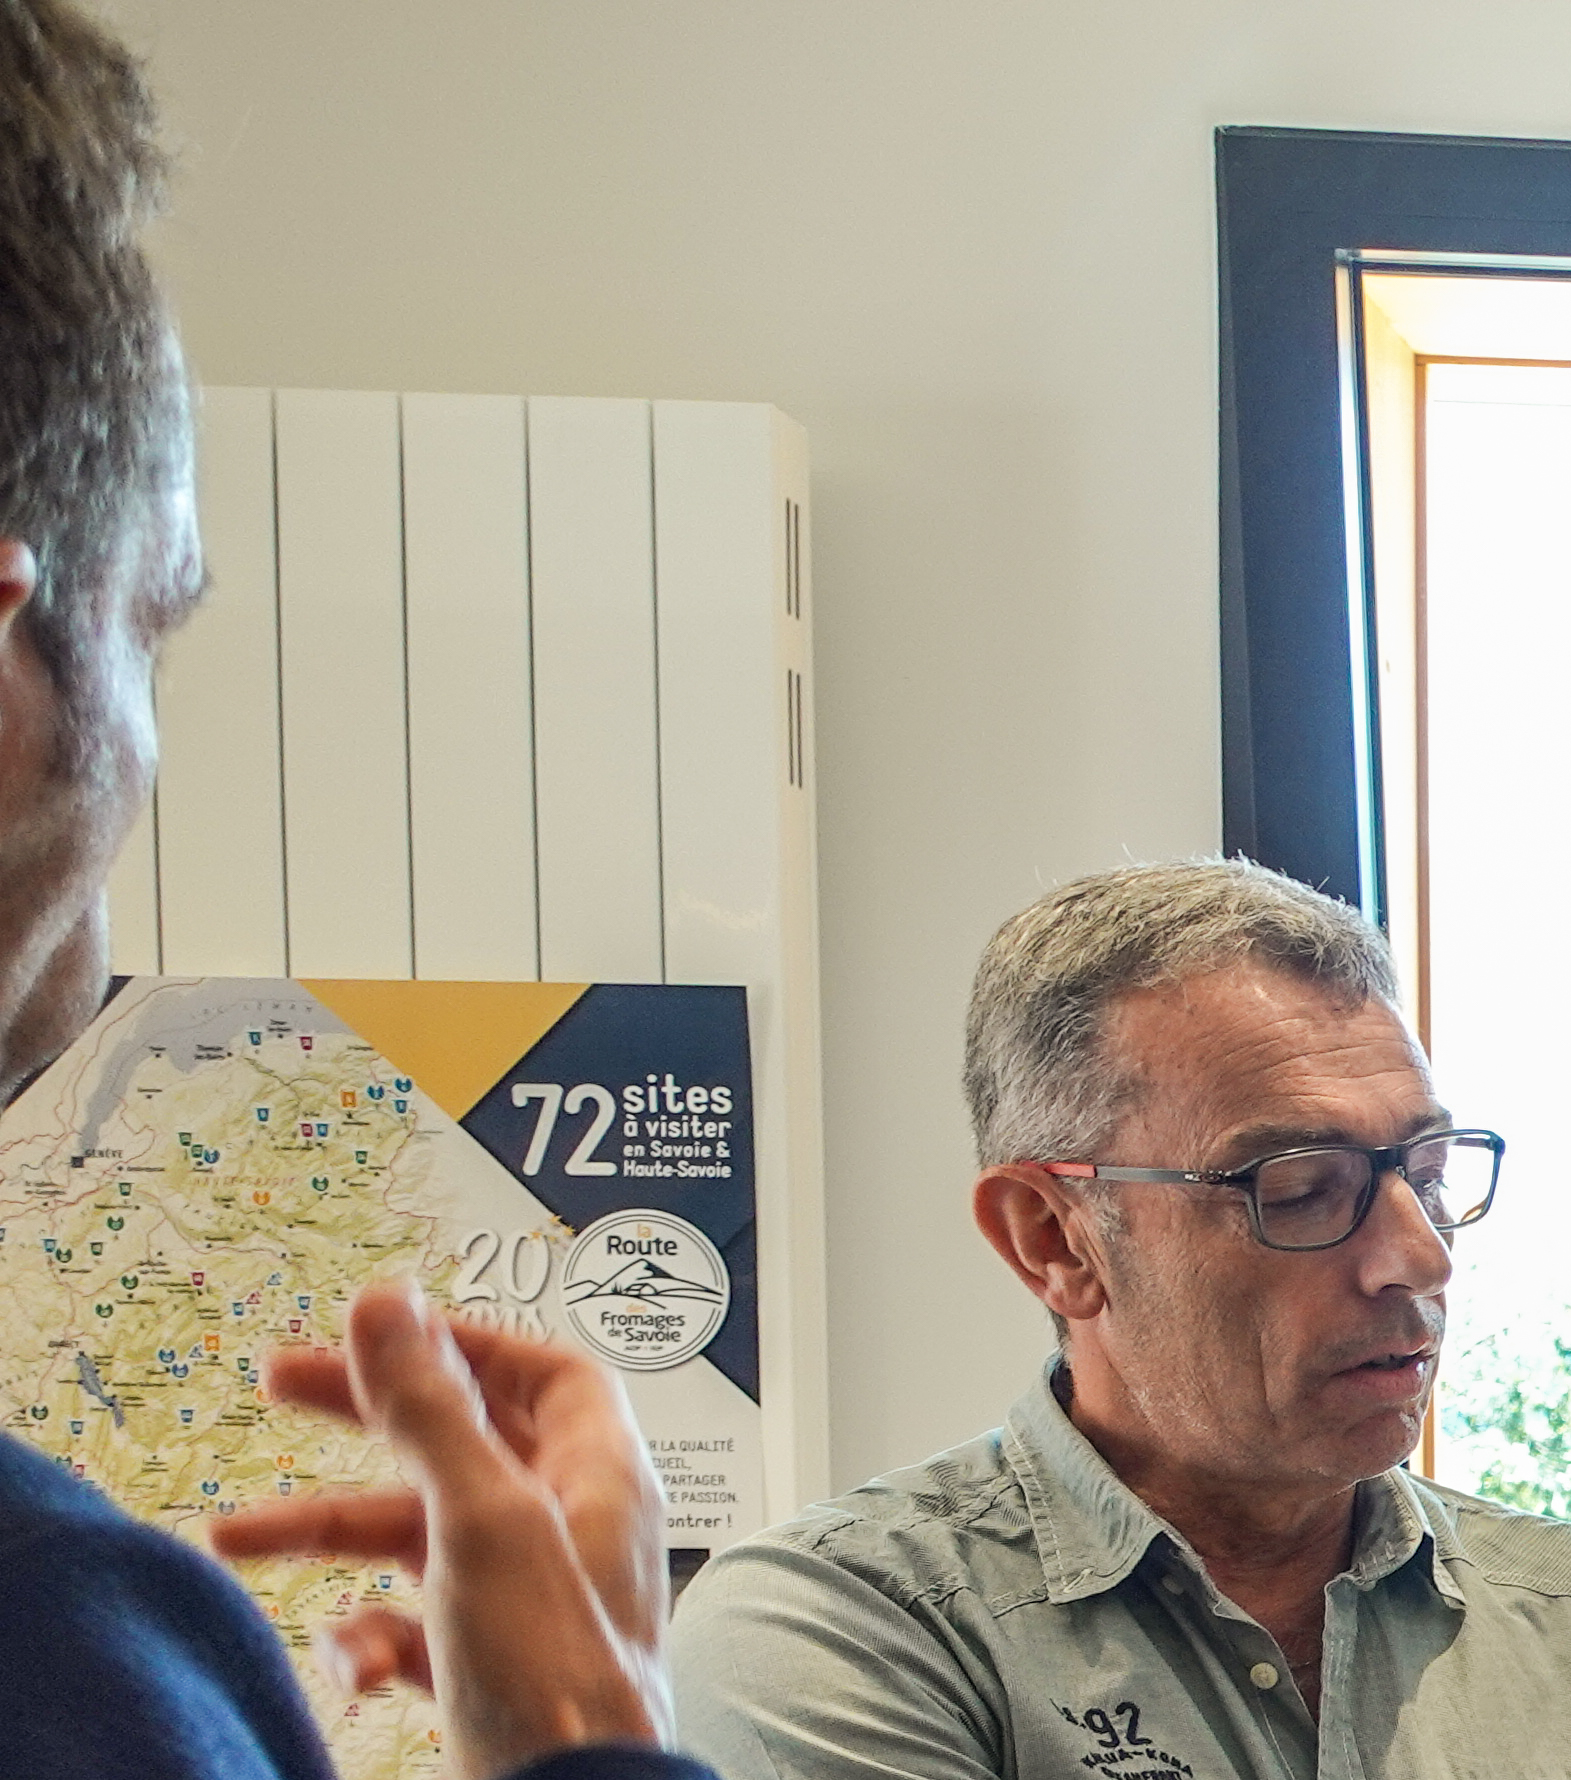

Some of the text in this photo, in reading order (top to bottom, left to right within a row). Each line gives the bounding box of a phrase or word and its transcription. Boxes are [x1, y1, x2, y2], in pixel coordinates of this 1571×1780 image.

[622, 1073, 733, 1115] sites
[511, 1083, 618, 1176] 72
[623, 1113, 732, 1138] à visiter
[623, 1140, 731, 1158] en Savoie &
[623, 1160, 732, 1179] Haute-Savoie
[637, 1224, 651, 1238] la
[606, 1235, 678, 1256] Route
[454, 1228, 551, 1303] 20
[601, 1311, 685, 1330] Fromages
[608, 1327, 681, 1342] de Savoie
[660, 1440, 676, 1452] LA
[679, 1437, 735, 1452] QUALITÉ
[663, 1474, 726, 1486] PARTAGER
